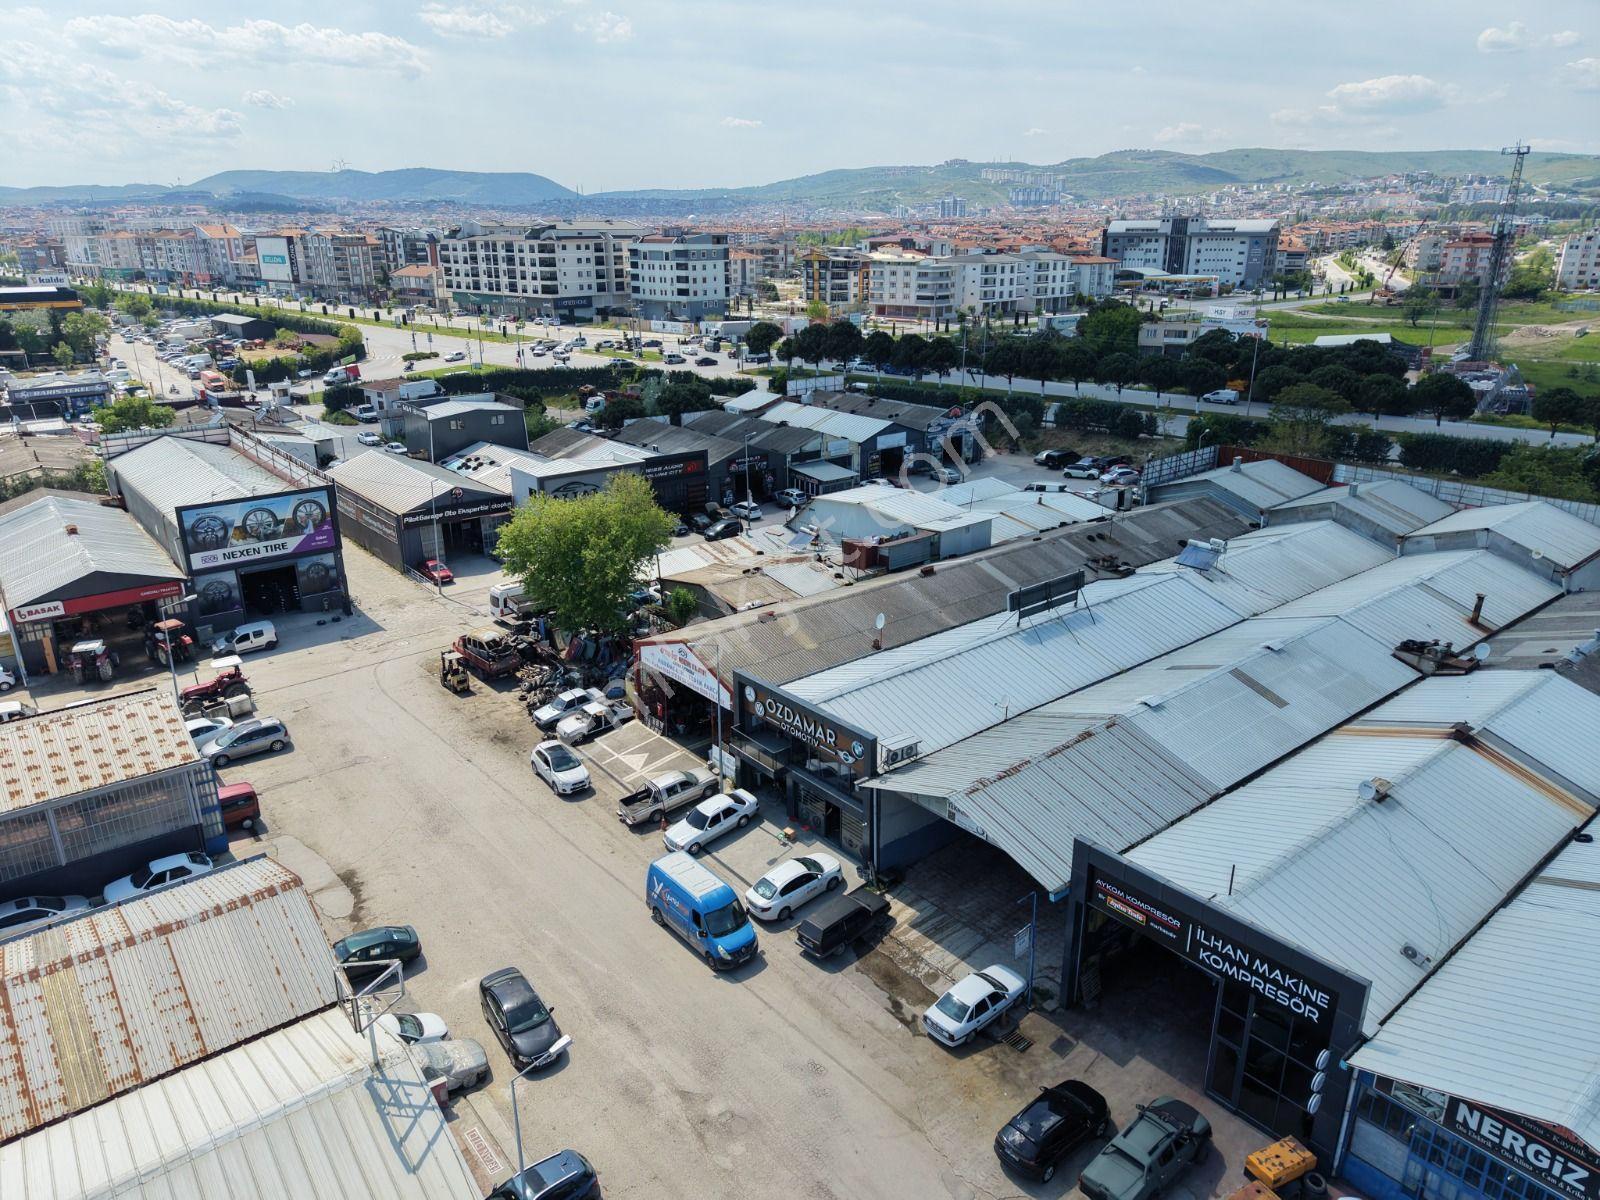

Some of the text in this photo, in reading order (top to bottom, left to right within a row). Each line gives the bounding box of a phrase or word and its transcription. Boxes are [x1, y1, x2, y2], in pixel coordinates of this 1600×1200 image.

[222, 541, 288, 561] NEXEN TIRE
[1095, 879, 1125, 898] AYKOM
[1196, 925, 1330, 1009] İLHAN MAKİNE
[1199, 948, 1319, 1024] KOMPRESÖR
[1501, 1148, 1514, 1160] Oto
[1541, 1171, 1557, 1186] Cam
